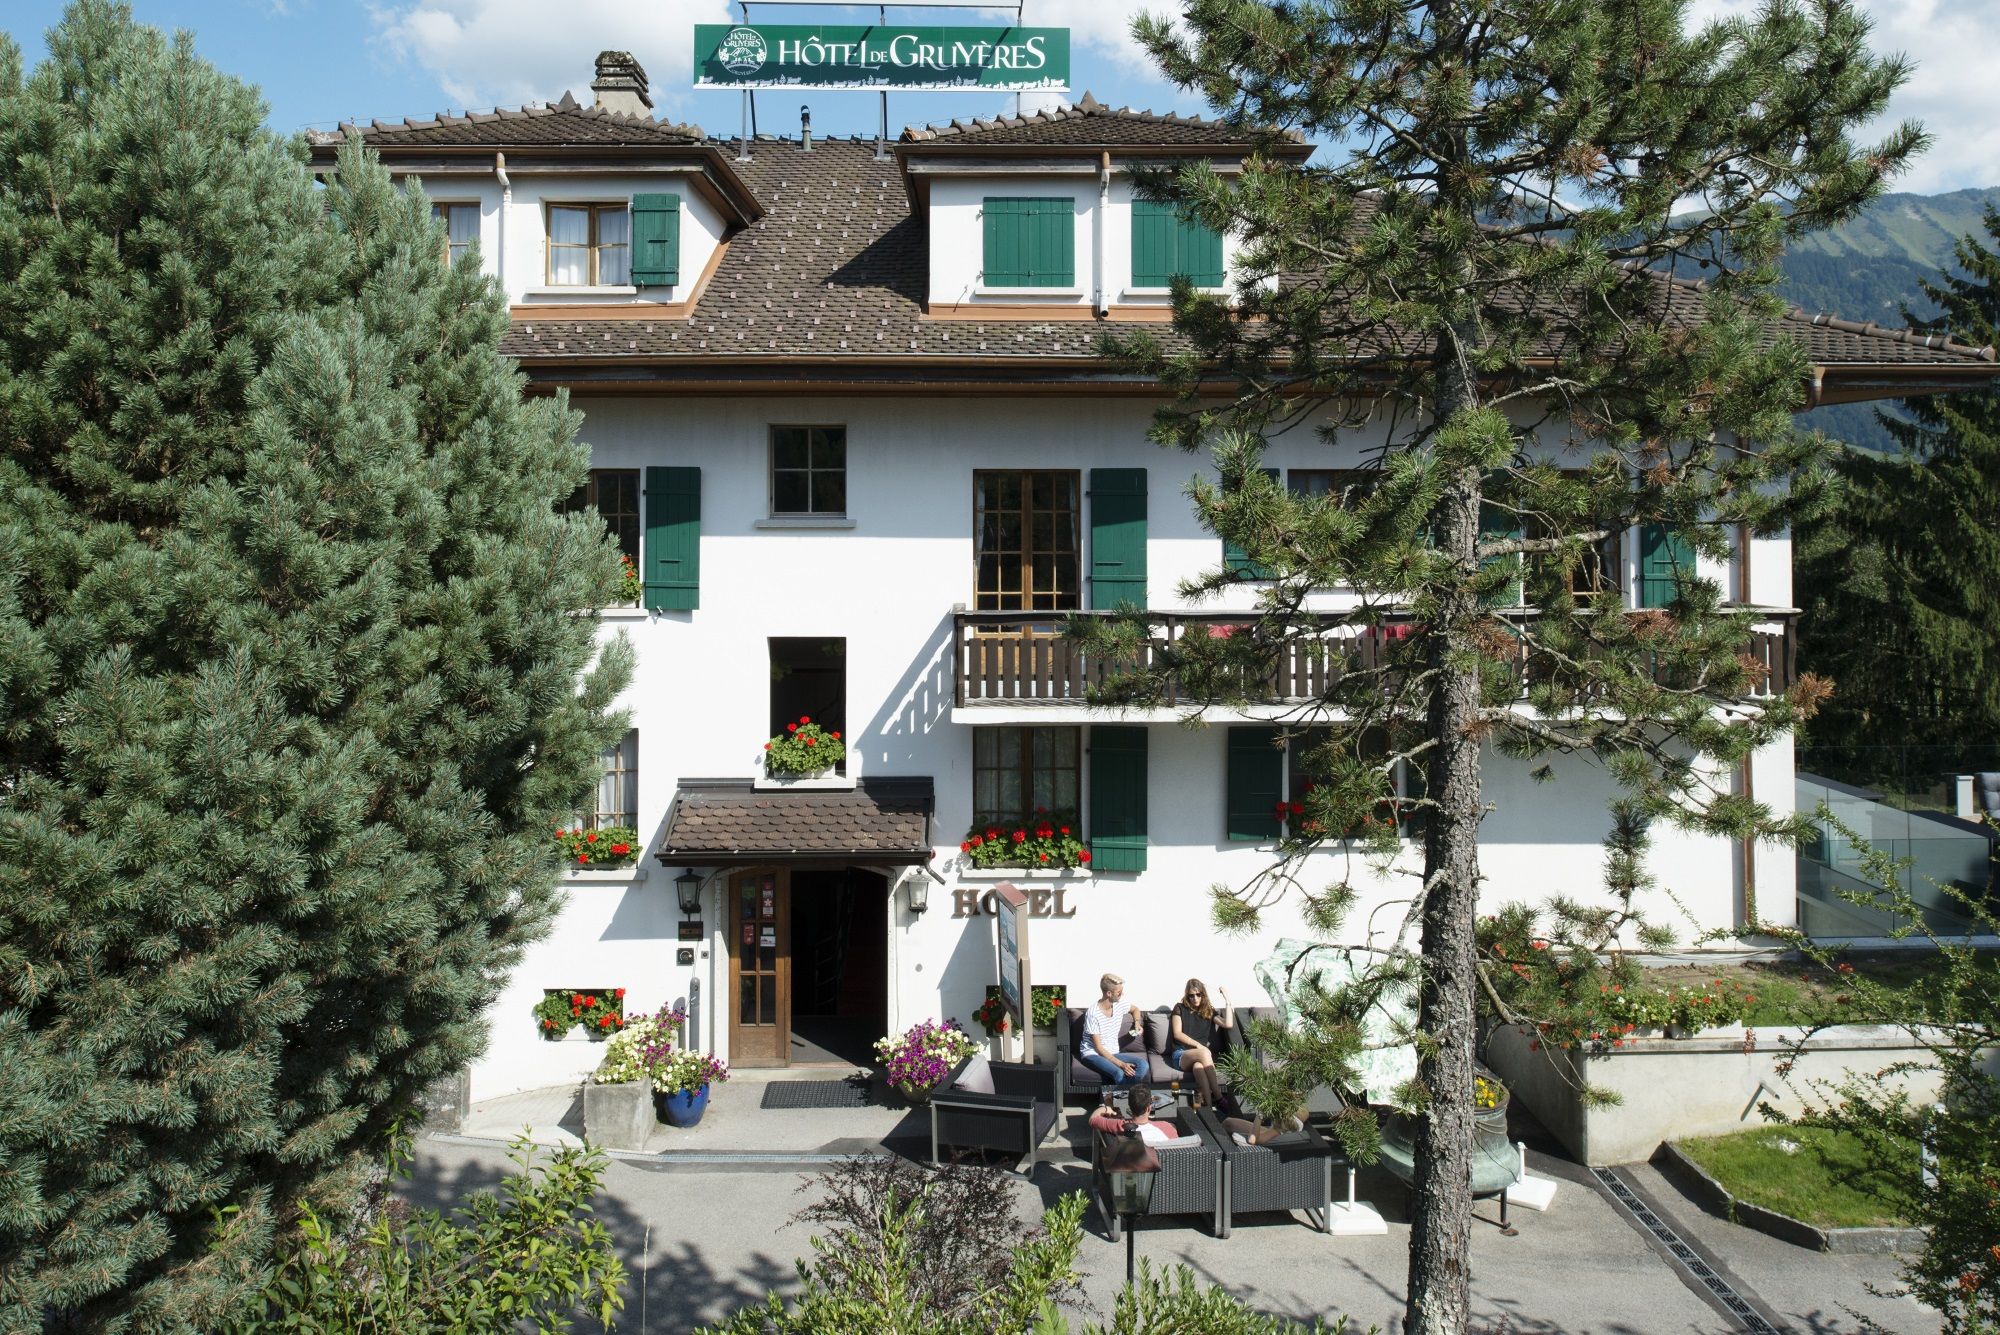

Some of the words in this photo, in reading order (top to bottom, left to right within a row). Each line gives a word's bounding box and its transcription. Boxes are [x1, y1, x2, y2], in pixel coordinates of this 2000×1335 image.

[778, 35, 880, 70] HÔTEL
[870, 50, 888, 63] DE
[889, 35, 1047, 71] GRUYÈRES
[951, 888, 1077, 918] HOEL
